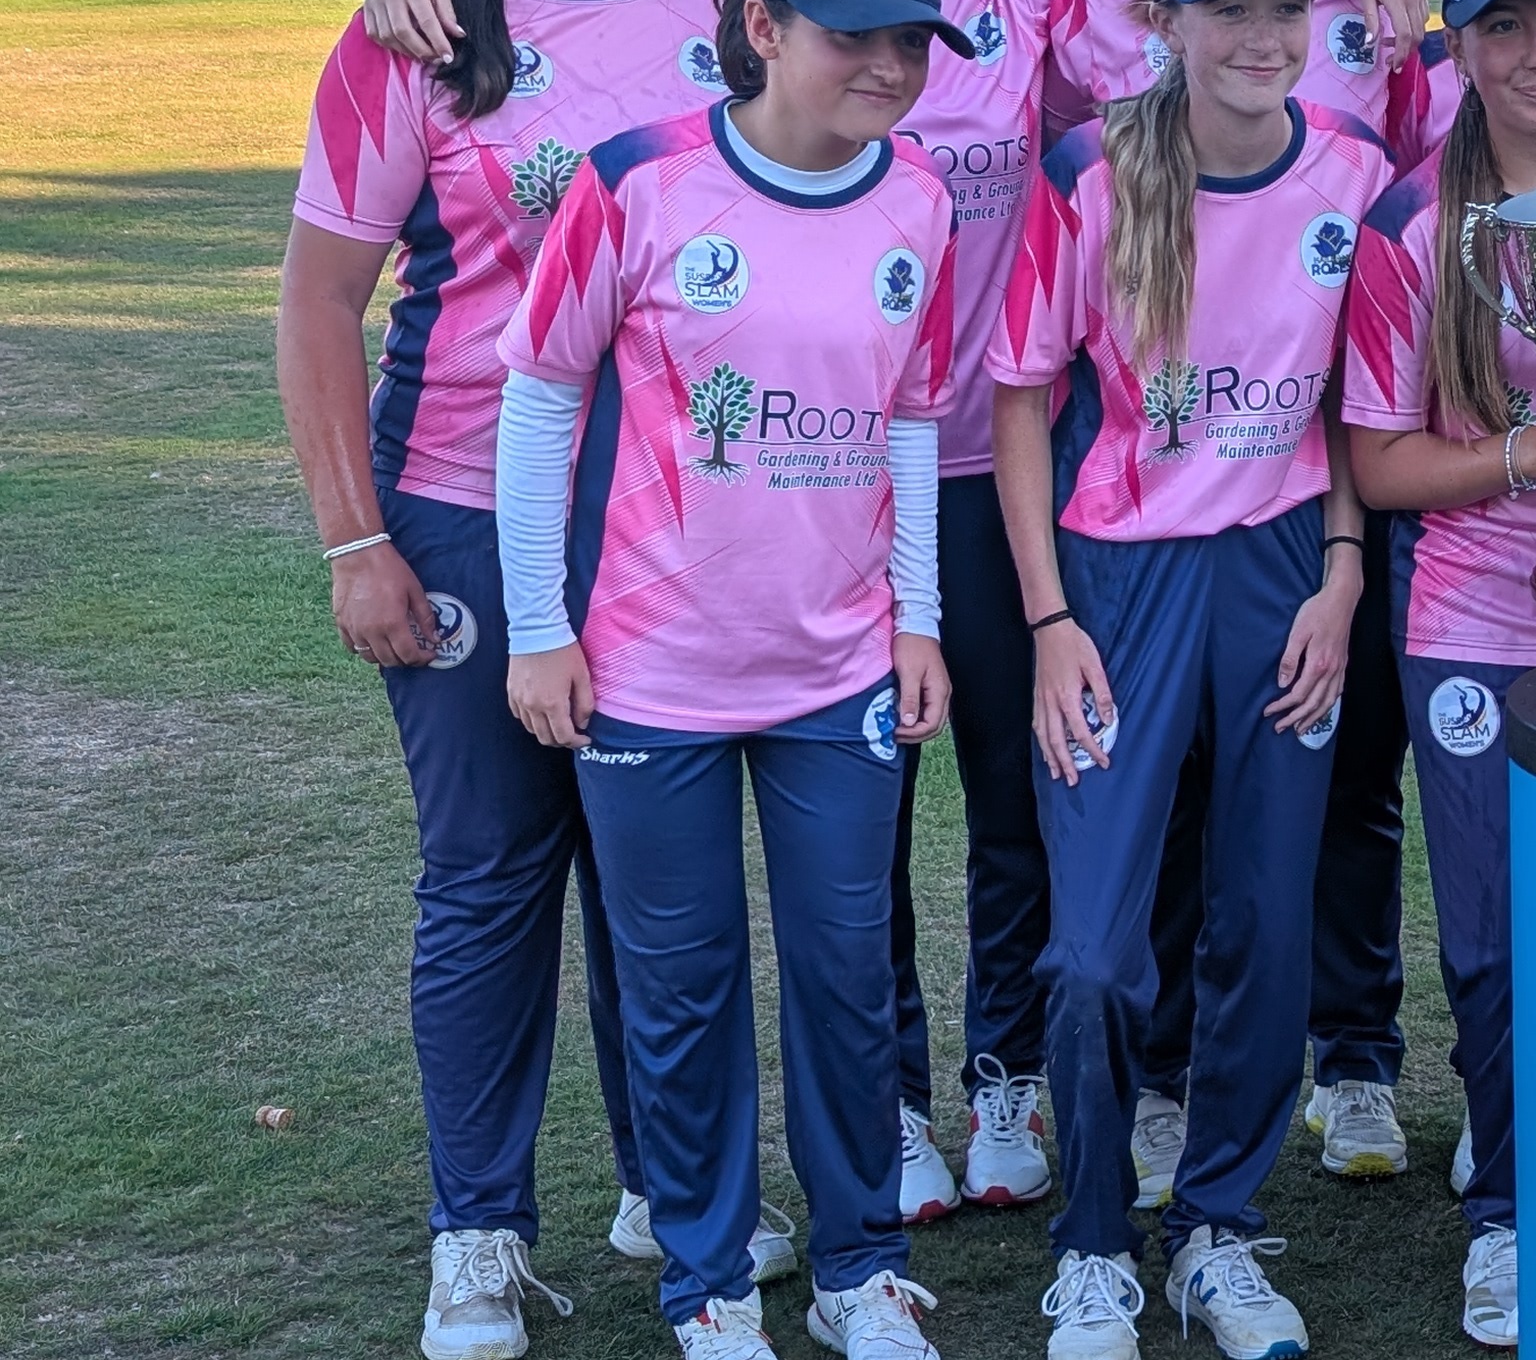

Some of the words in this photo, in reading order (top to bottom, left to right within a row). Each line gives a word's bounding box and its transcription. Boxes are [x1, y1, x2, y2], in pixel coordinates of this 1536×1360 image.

[972, 184, 982, 200] &
[684, 282, 739, 298] SLAM
[759, 389, 883, 441] ROOT
[1205, 420, 1278, 440] Gardening
[1281, 419, 1290, 434] &
[757, 449, 830, 472] Gardening
[832, 450, 842, 467] &
[767, 471, 851, 489] Maintenance
[854, 471, 879, 486] Ltd
[1441, 723, 1490, 741] SLAM
[580, 745, 651, 766] Sharks
